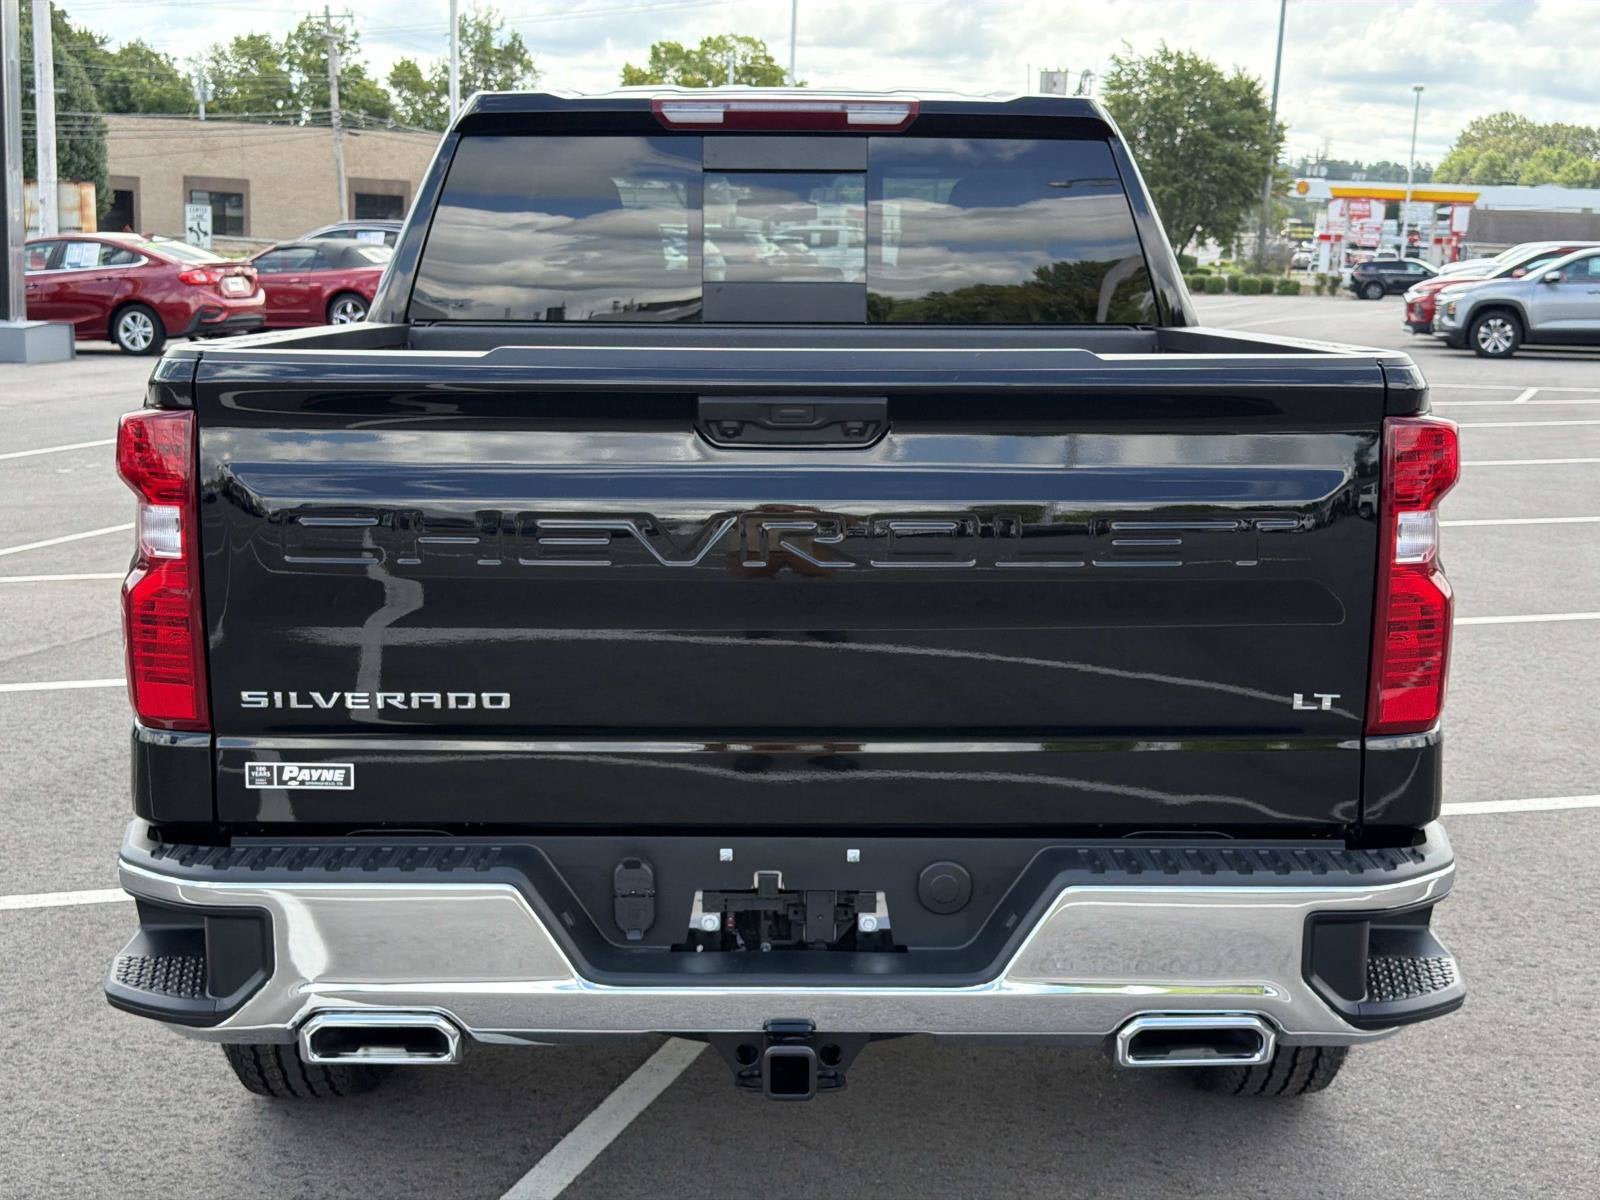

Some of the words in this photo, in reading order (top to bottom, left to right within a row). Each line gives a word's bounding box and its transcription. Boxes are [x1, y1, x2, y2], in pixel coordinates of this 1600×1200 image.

[281, 506, 1304, 568] CHEVROLET
[240, 690, 511, 710] SILVERADO
[1292, 692, 1341, 711] LT
